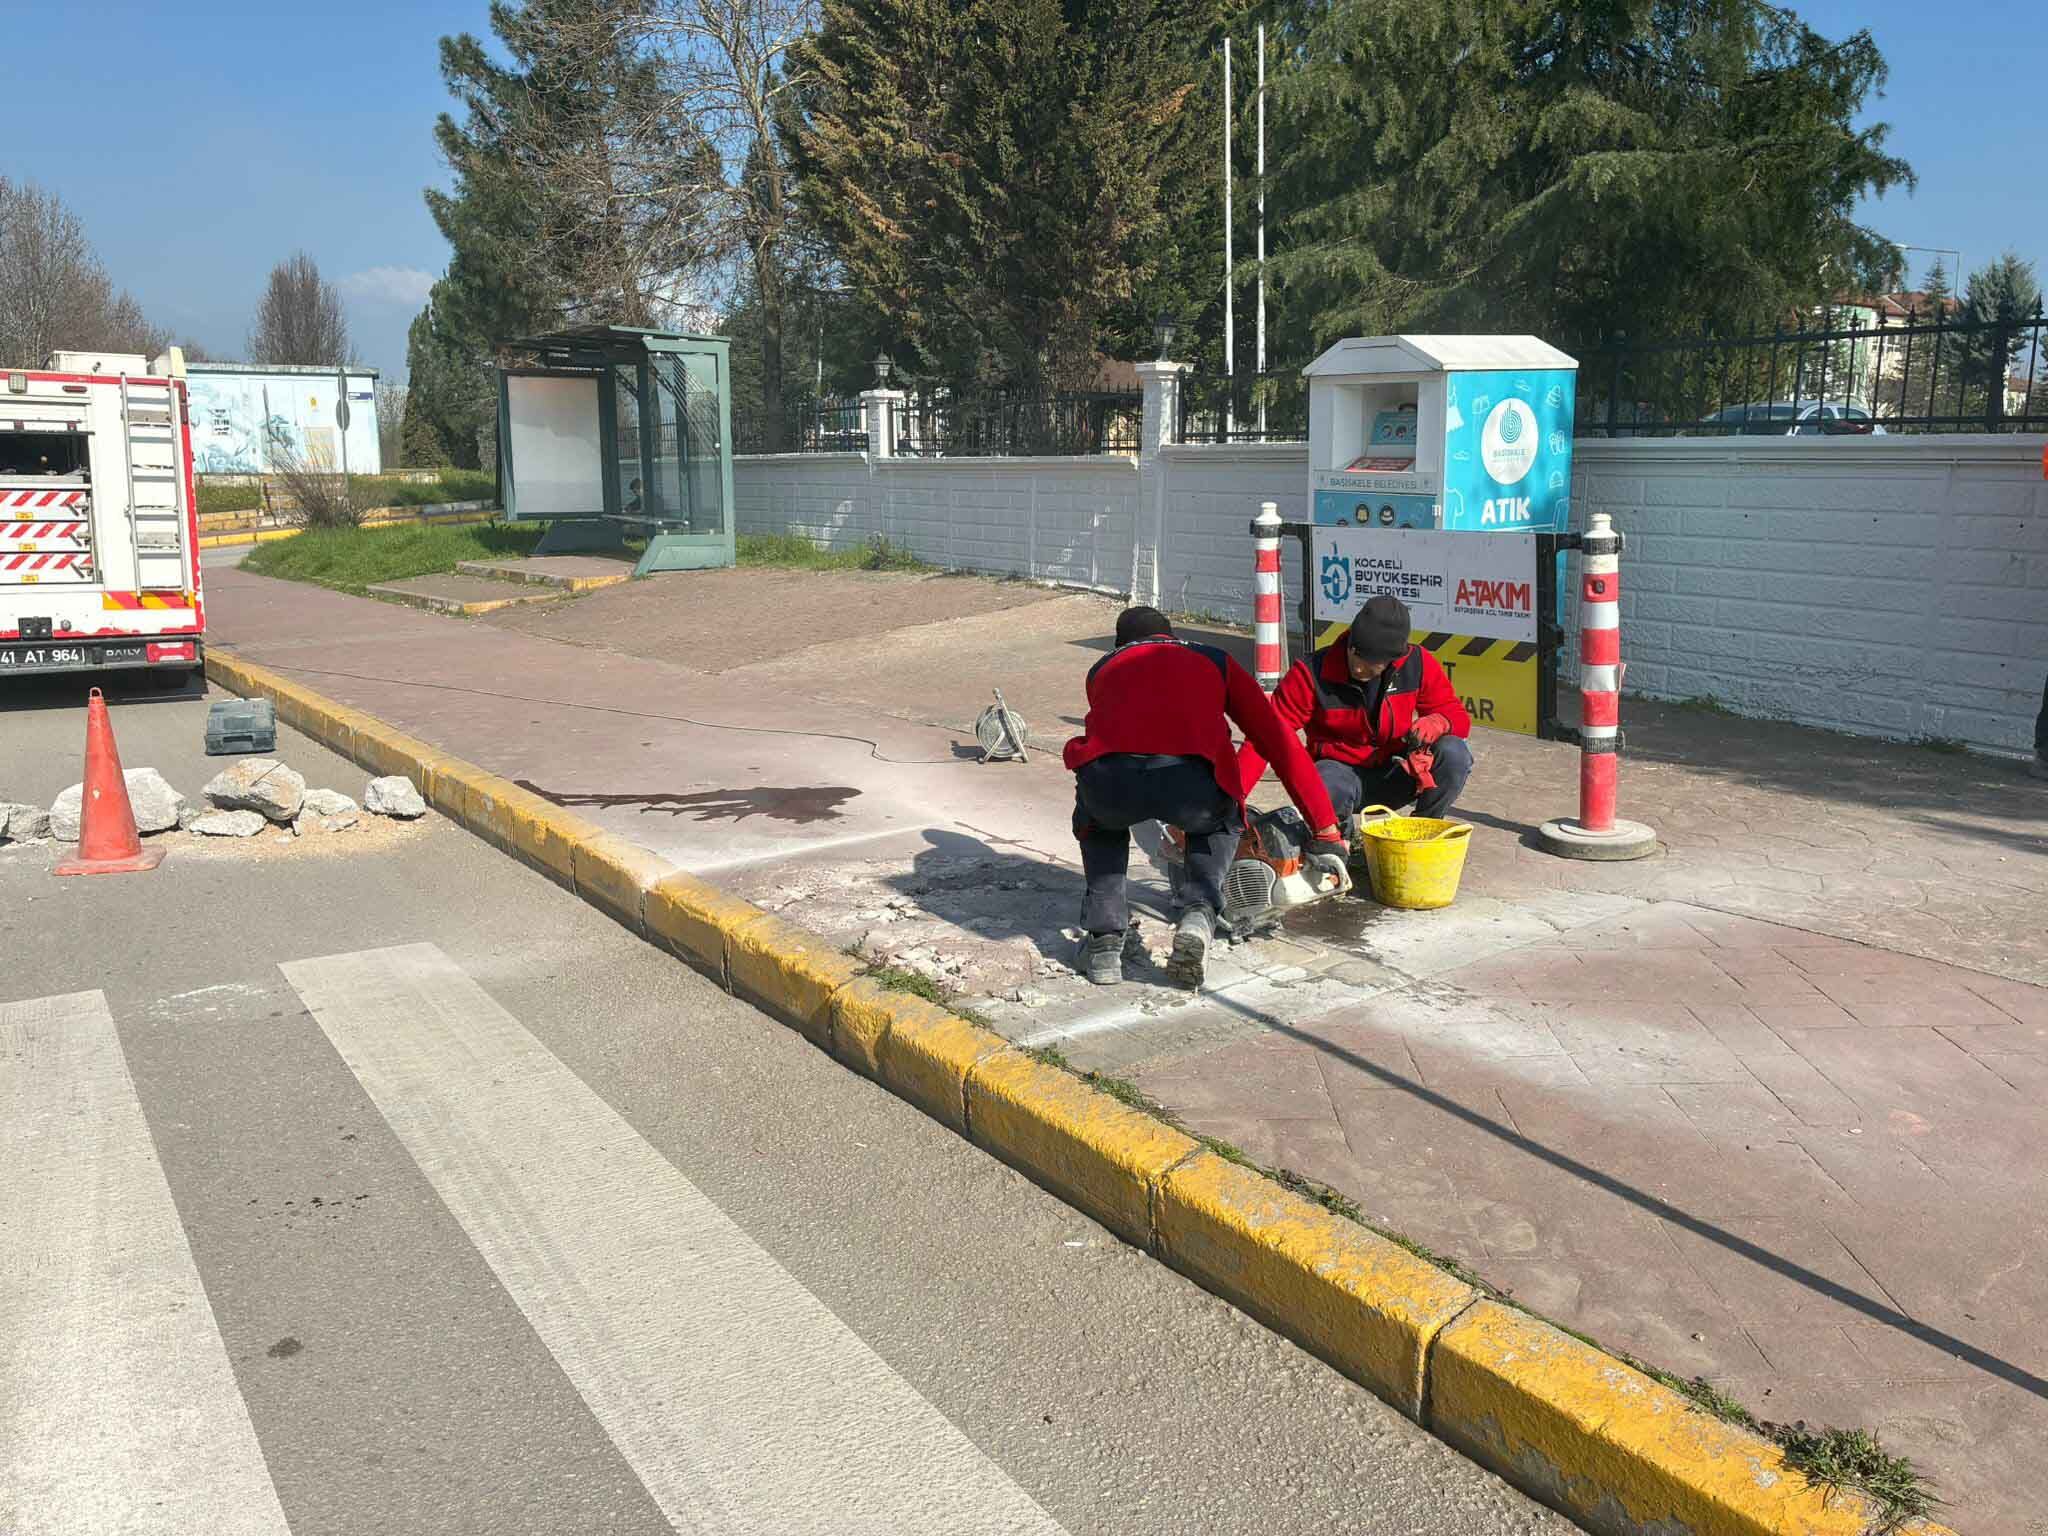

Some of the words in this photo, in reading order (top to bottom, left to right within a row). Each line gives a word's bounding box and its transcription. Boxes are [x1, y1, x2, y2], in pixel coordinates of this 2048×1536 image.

[1482, 496, 1531, 524] ATIK
[1, 650, 16, 664] 41
[24, 649, 46, 663] AT
[52, 648, 80, 661] 964
